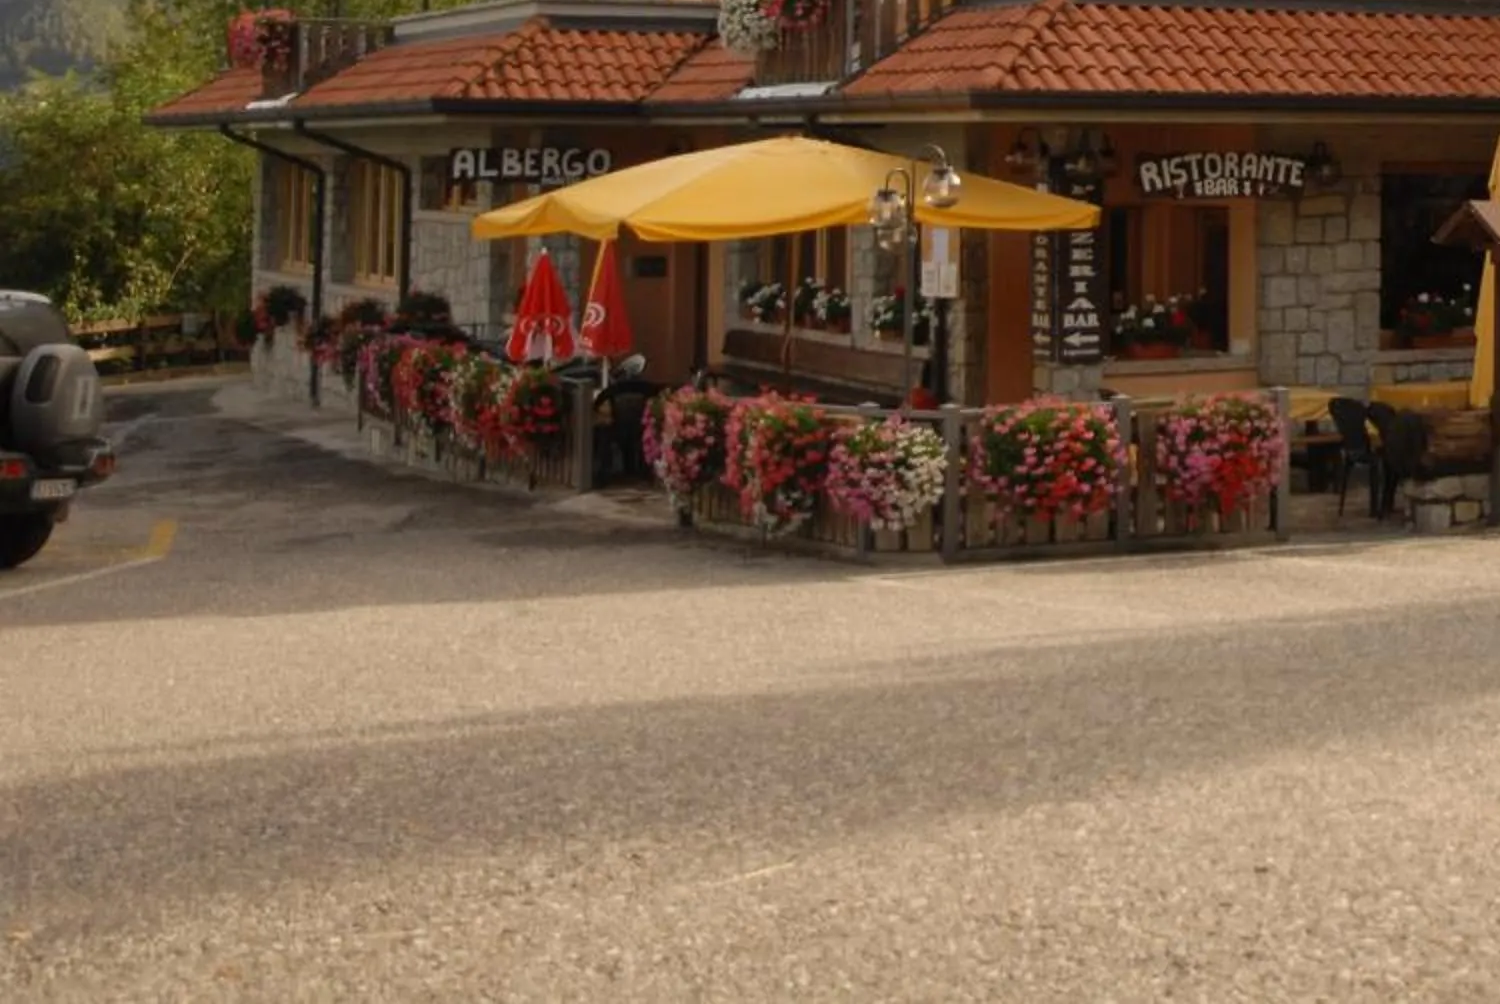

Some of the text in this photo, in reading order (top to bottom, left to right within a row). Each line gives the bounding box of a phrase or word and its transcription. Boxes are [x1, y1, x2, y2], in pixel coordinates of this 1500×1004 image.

[453, 148, 611, 179] ALBERGO
[1139, 152, 1305, 192] RISTORANTE
[1203, 177, 1239, 196] BAR
[1063, 313, 1099, 328] BAR
